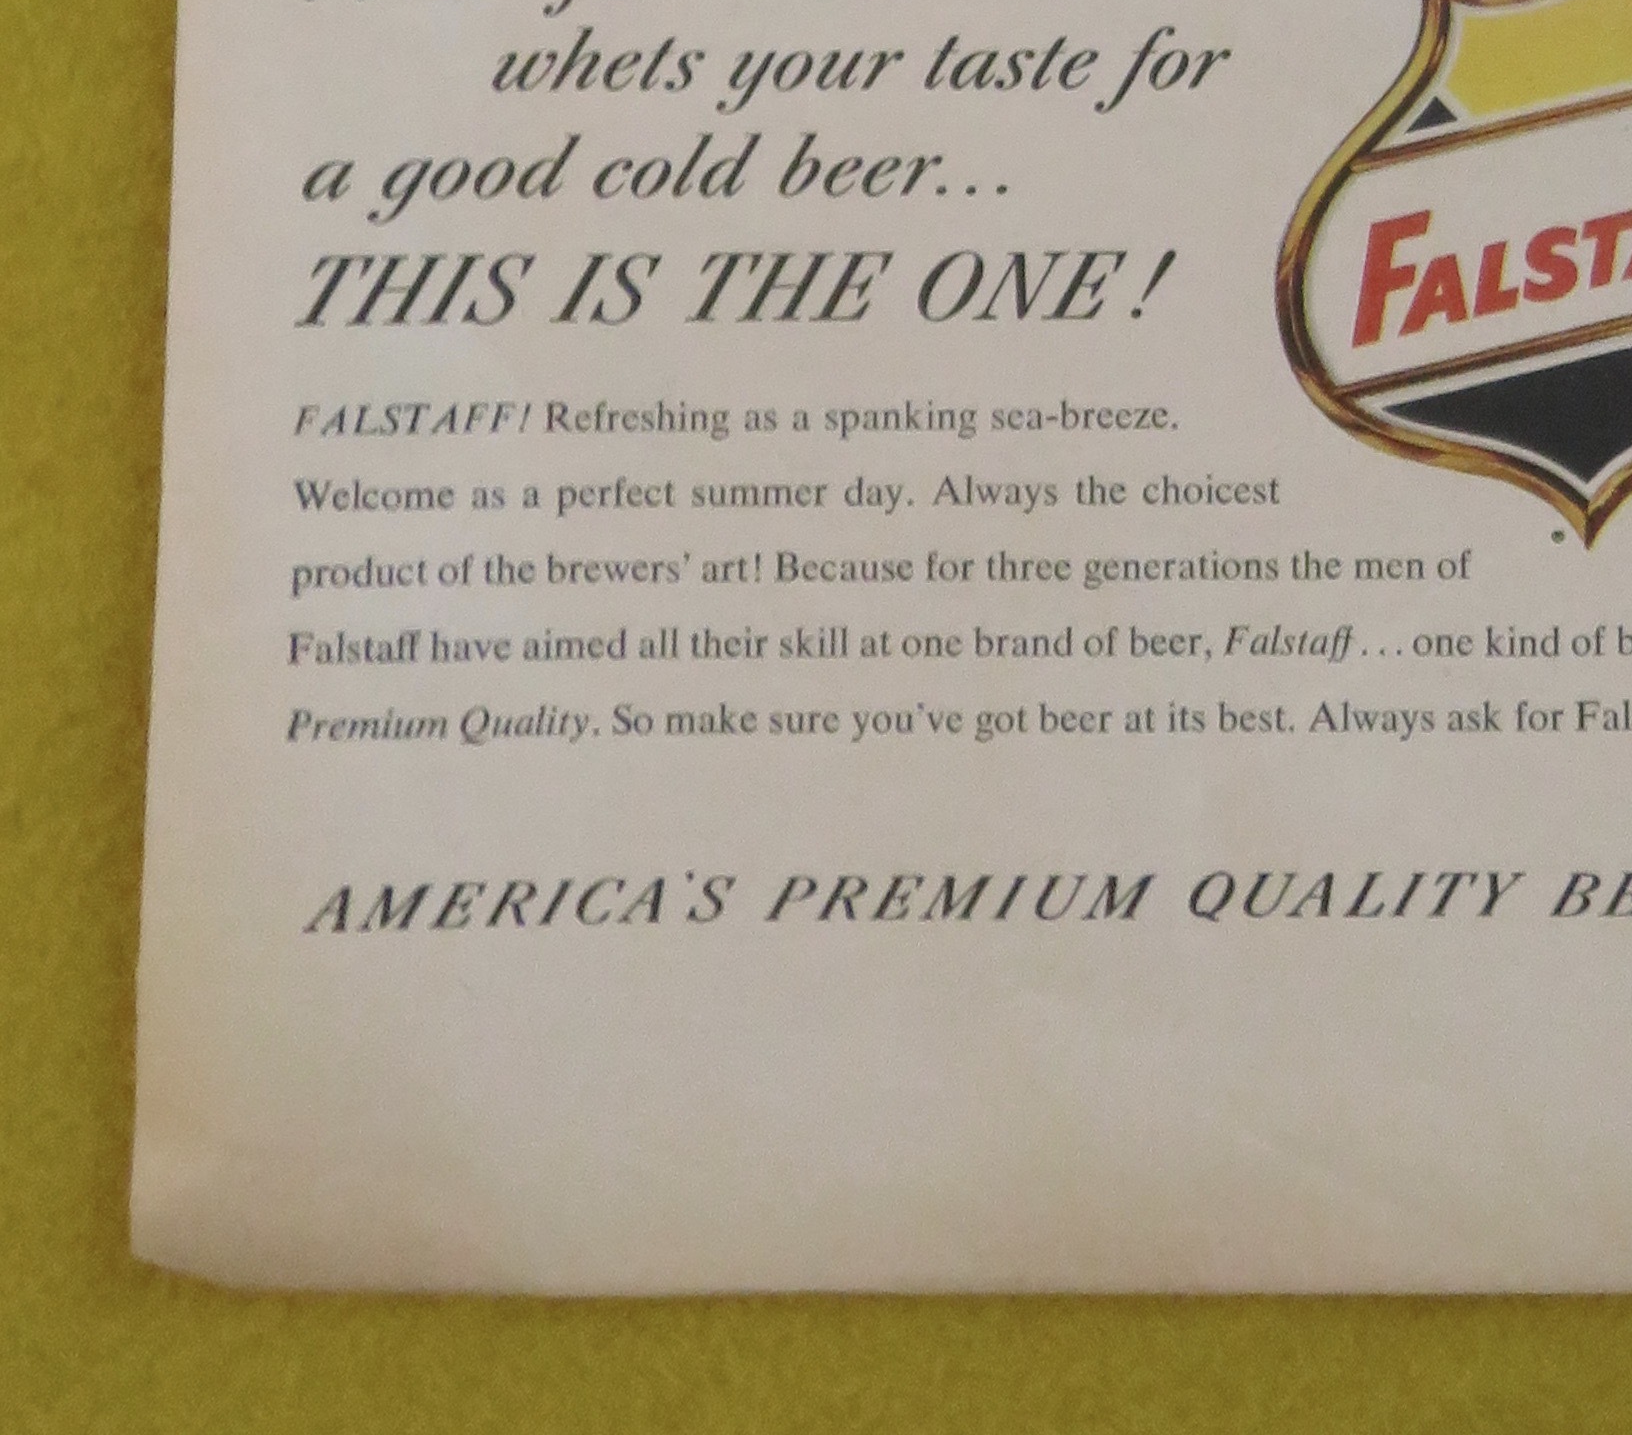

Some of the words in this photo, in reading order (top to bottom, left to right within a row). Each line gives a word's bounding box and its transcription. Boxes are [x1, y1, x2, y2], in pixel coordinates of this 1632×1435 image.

[491, 26, 706, 93] whets
[715, 49, 906, 113] your
[924, 34, 1100, 91] taste
[1092, 25, 1232, 114] for
[301, 160, 351, 203] a
[366, 133, 582, 223] good
[592, 132, 762, 199] cold
[295, 254, 536, 327] THIS
[555, 253, 662, 325] IS
[689, 251, 894, 322] THE
[294, 402, 532, 437] FALSTAFF!
[545, 399, 730, 441] Refreshing
[743, 408, 779, 432] as
[792, 410, 811, 432] a
[824, 399, 978, 441] spanking
[991, 398, 1179, 431] sea-breeze.
[293, 478, 455, 512] Welcome
[471, 487, 506, 510] as
[522, 486, 540, 509] a
[557, 476, 675, 518] perfect
[691, 483, 828, 508] summer
[843, 475, 914, 516] day.
[932, 474, 1059, 515] Always
[1075, 474, 1127, 506] the
[1142, 473, 1281, 506] choicest
[291, 555, 427, 599] product
[437, 553, 475, 586] of
[484, 553, 536, 585] the
[701, 552, 762, 584] art!
[775, 550, 914, 583] Because
[926, 550, 975, 582] for
[986, 549, 1072, 582] three
[1083, 549, 1280, 591] generations
[1291, 549, 1342, 581] the
[1354, 558, 1425, 581] men
[1436, 548, 1472, 580] of
[288, 629, 421, 666] Falstaff
[430, 630, 512, 663] have
[522, 627, 627, 662] aimed
[638, 626, 679, 660] all
[690, 626, 769, 659] their
[779, 625, 849, 659] skill
[859, 630, 892, 658] at
[901, 634, 963, 658] one
[973, 625, 1073, 658] brand
[1083, 625, 1120, 658] of
[1129, 625, 1213, 661] beer,
[1412, 634, 1474, 657] one
[1485, 625, 1560, 658] kind
[1571, 624, 1607, 657] of
[286, 708, 449, 742] Premium
[459, 704, 600, 746] Quality.
[612, 703, 654, 736] So
[665, 702, 758, 735] make
[769, 711, 840, 735] sure
[974, 706, 1028, 744] got
[1039, 702, 1113, 734] beer
[1124, 706, 1155, 734] at
[1168, 701, 1207, 733] its
[1218, 700, 1295, 733] best.
[1308, 700, 1436, 742] Always
[1447, 699, 1502, 733] ask
[1515, 700, 1565, 733] for
[765, 873, 1156, 922] PREMIUM
[1188, 870, 1525, 923] QUALITY
